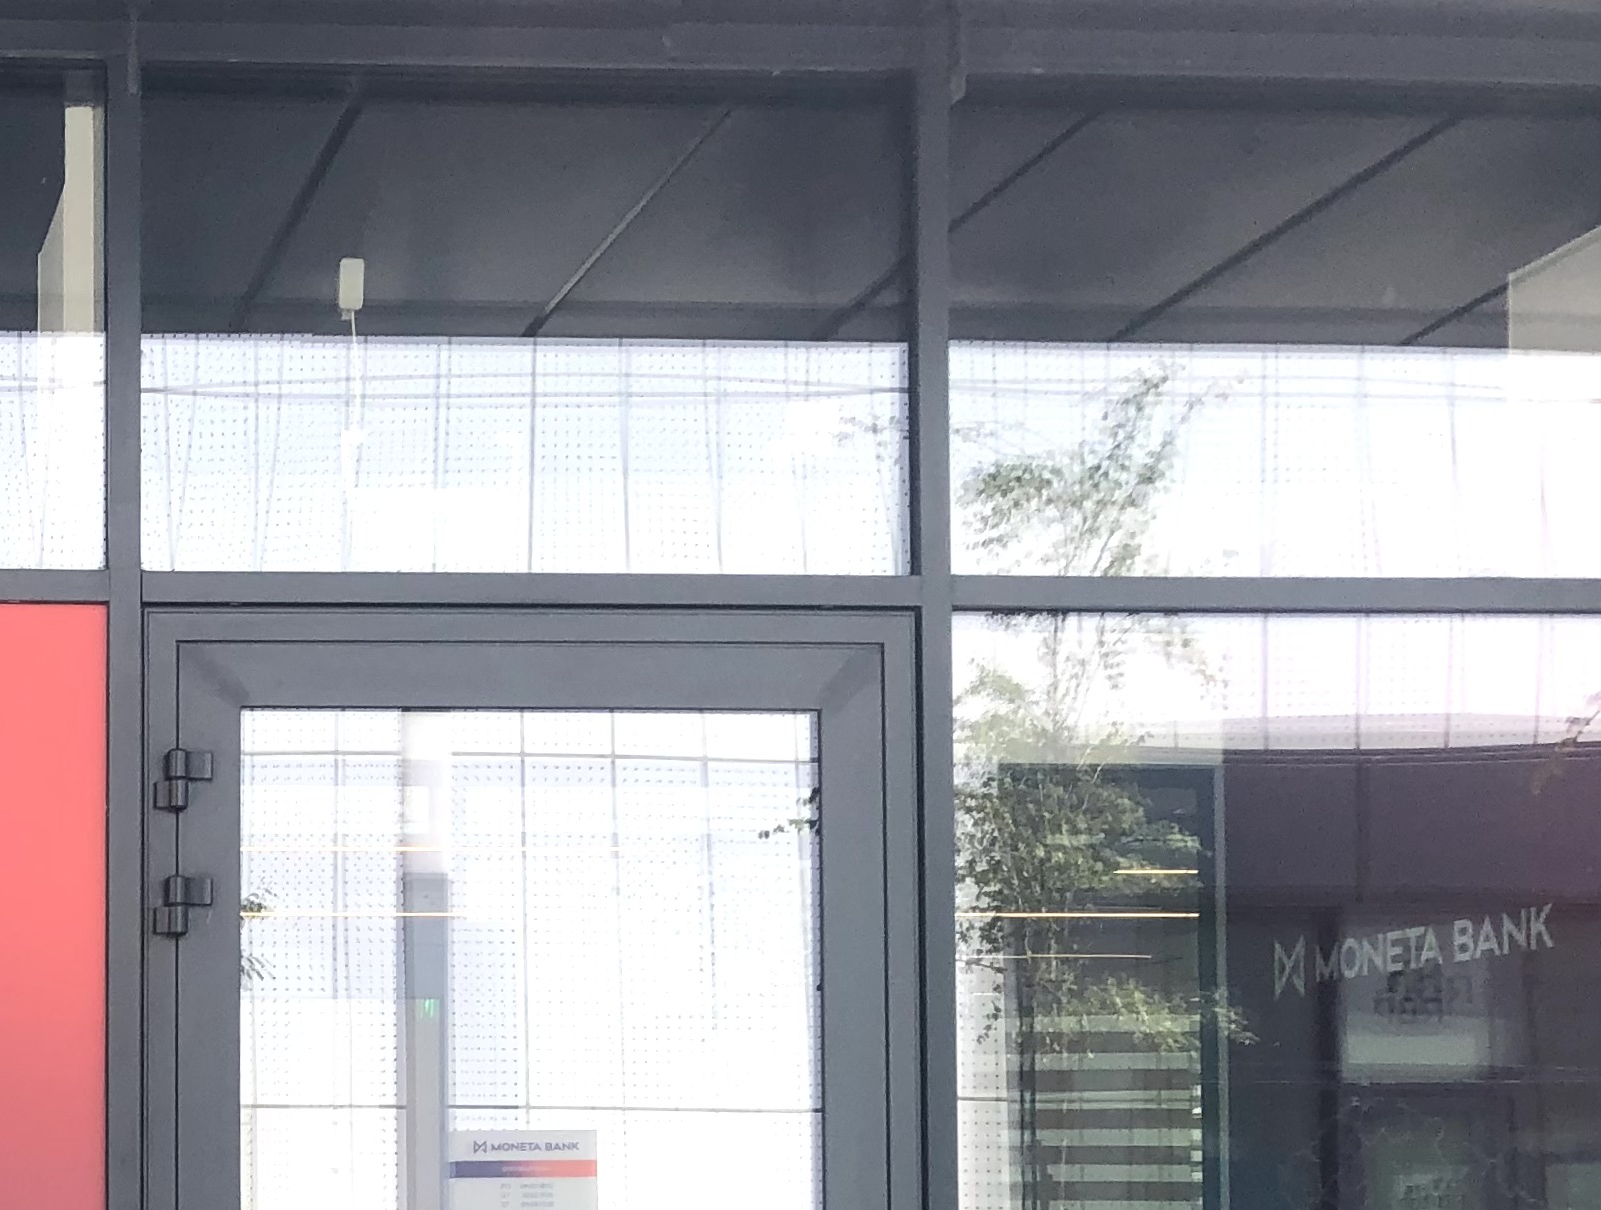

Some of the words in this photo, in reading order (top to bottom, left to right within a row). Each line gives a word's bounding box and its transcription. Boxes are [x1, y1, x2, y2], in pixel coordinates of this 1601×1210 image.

[1314, 926, 1443, 983] MONETA
[1452, 903, 1554, 963] BANK
[490, 1142, 542, 1151] MONETA
[545, 1141, 580, 1151] BANK
